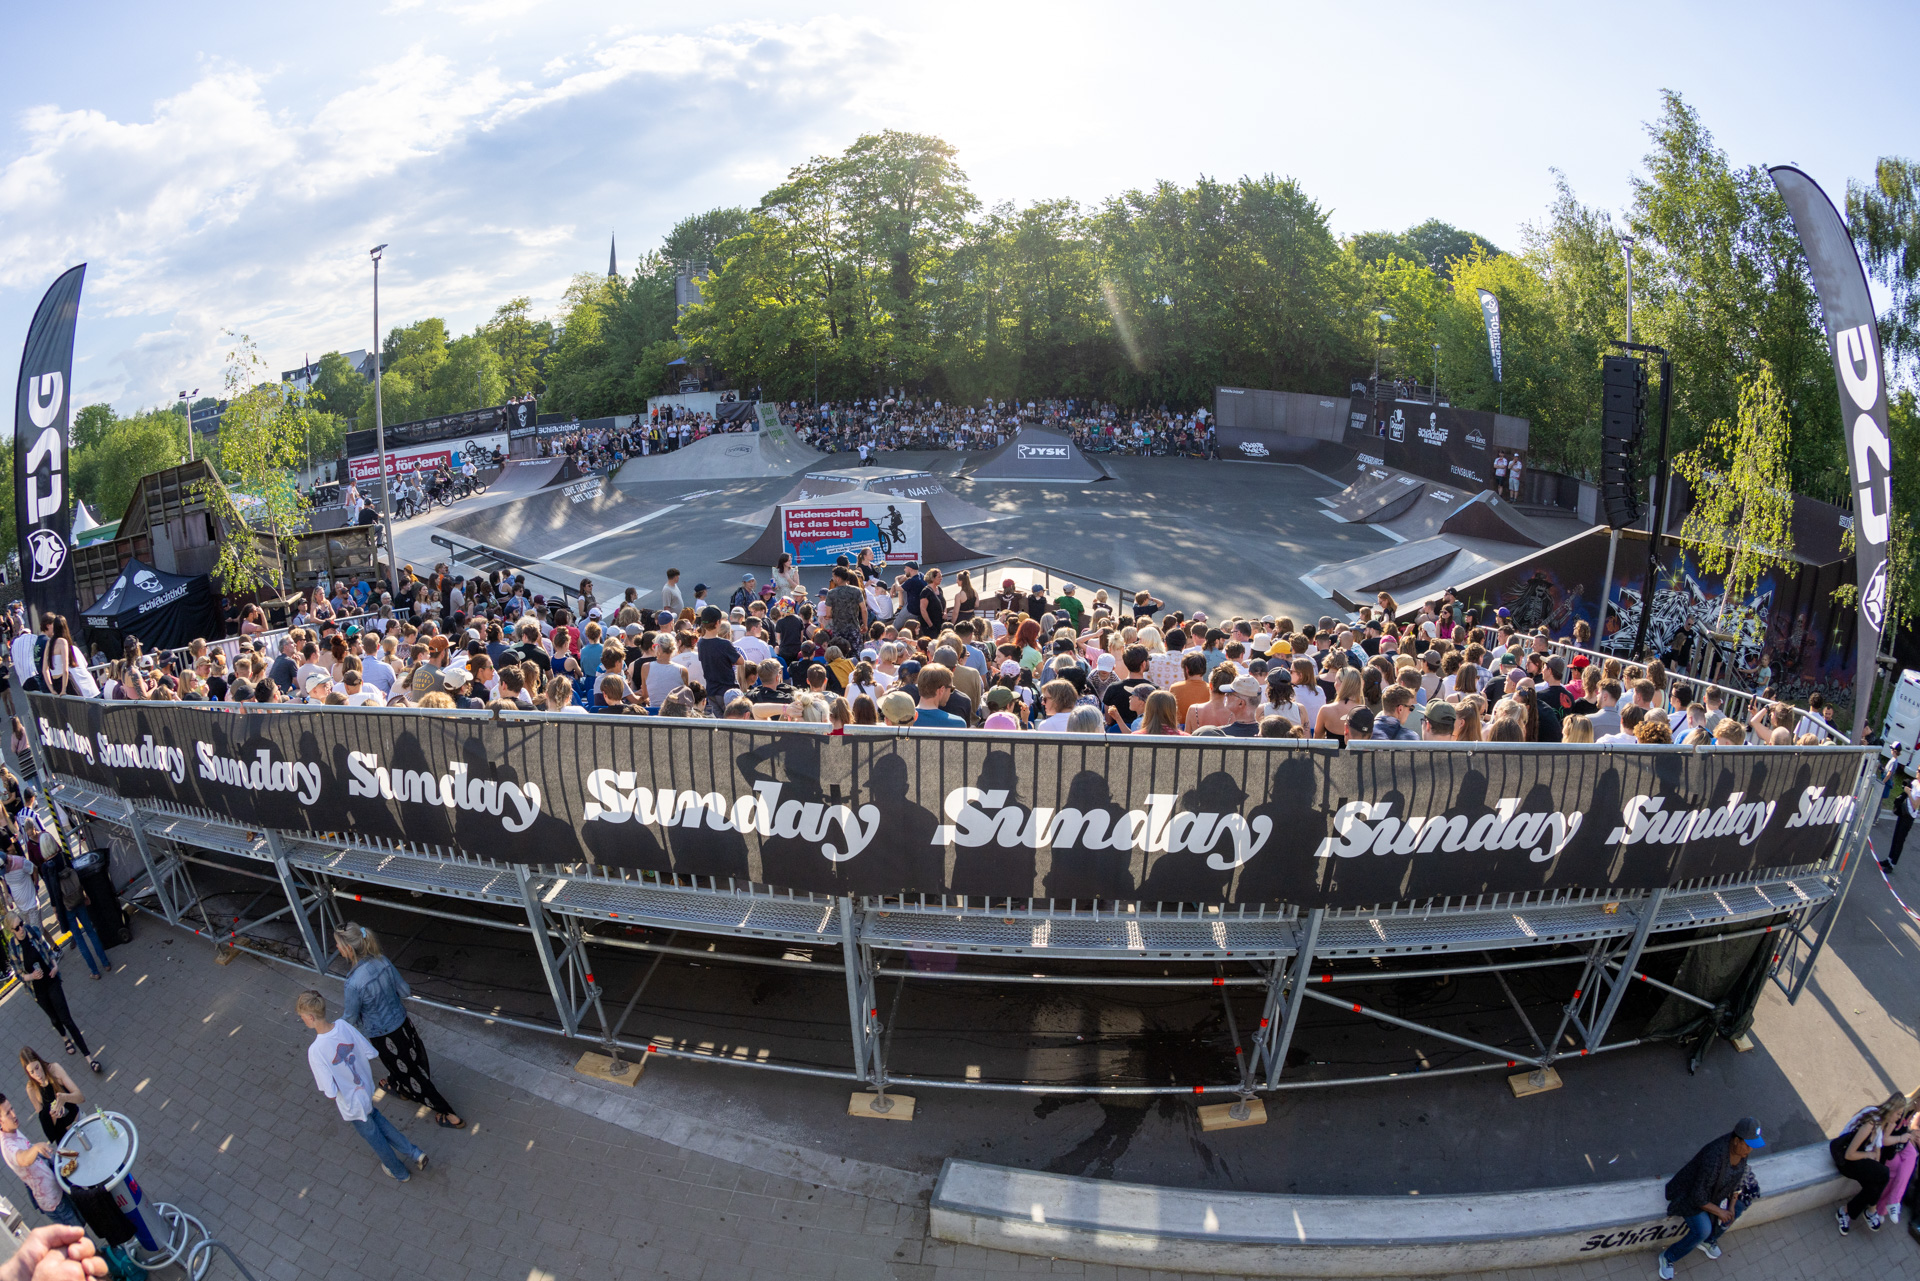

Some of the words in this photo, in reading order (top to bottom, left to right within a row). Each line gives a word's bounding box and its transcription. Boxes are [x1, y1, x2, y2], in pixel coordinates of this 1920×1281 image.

[26, 371, 64, 525] TSG
[1028, 447, 1066, 456] JYSK
[350, 464, 393, 478] Talene
[907, 485, 944, 497] NAH.SH
[788, 509, 859, 519] Leidenschaft
[833, 519, 867, 527] beste
[789, 529, 850, 538] Werkzeug.
[38, 717, 95, 766] Sunday
[96, 732, 185, 784] Sunday
[196, 740, 322, 805] Sunday
[347, 750, 541, 832] Sunday
[583, 768, 880, 862] Sunday
[931, 786, 1273, 870] Sunday
[1314, 797, 1584, 862] Sunday
[1604, 791, 1777, 846] Sunday
[1784, 785, 1855, 828] Sun
